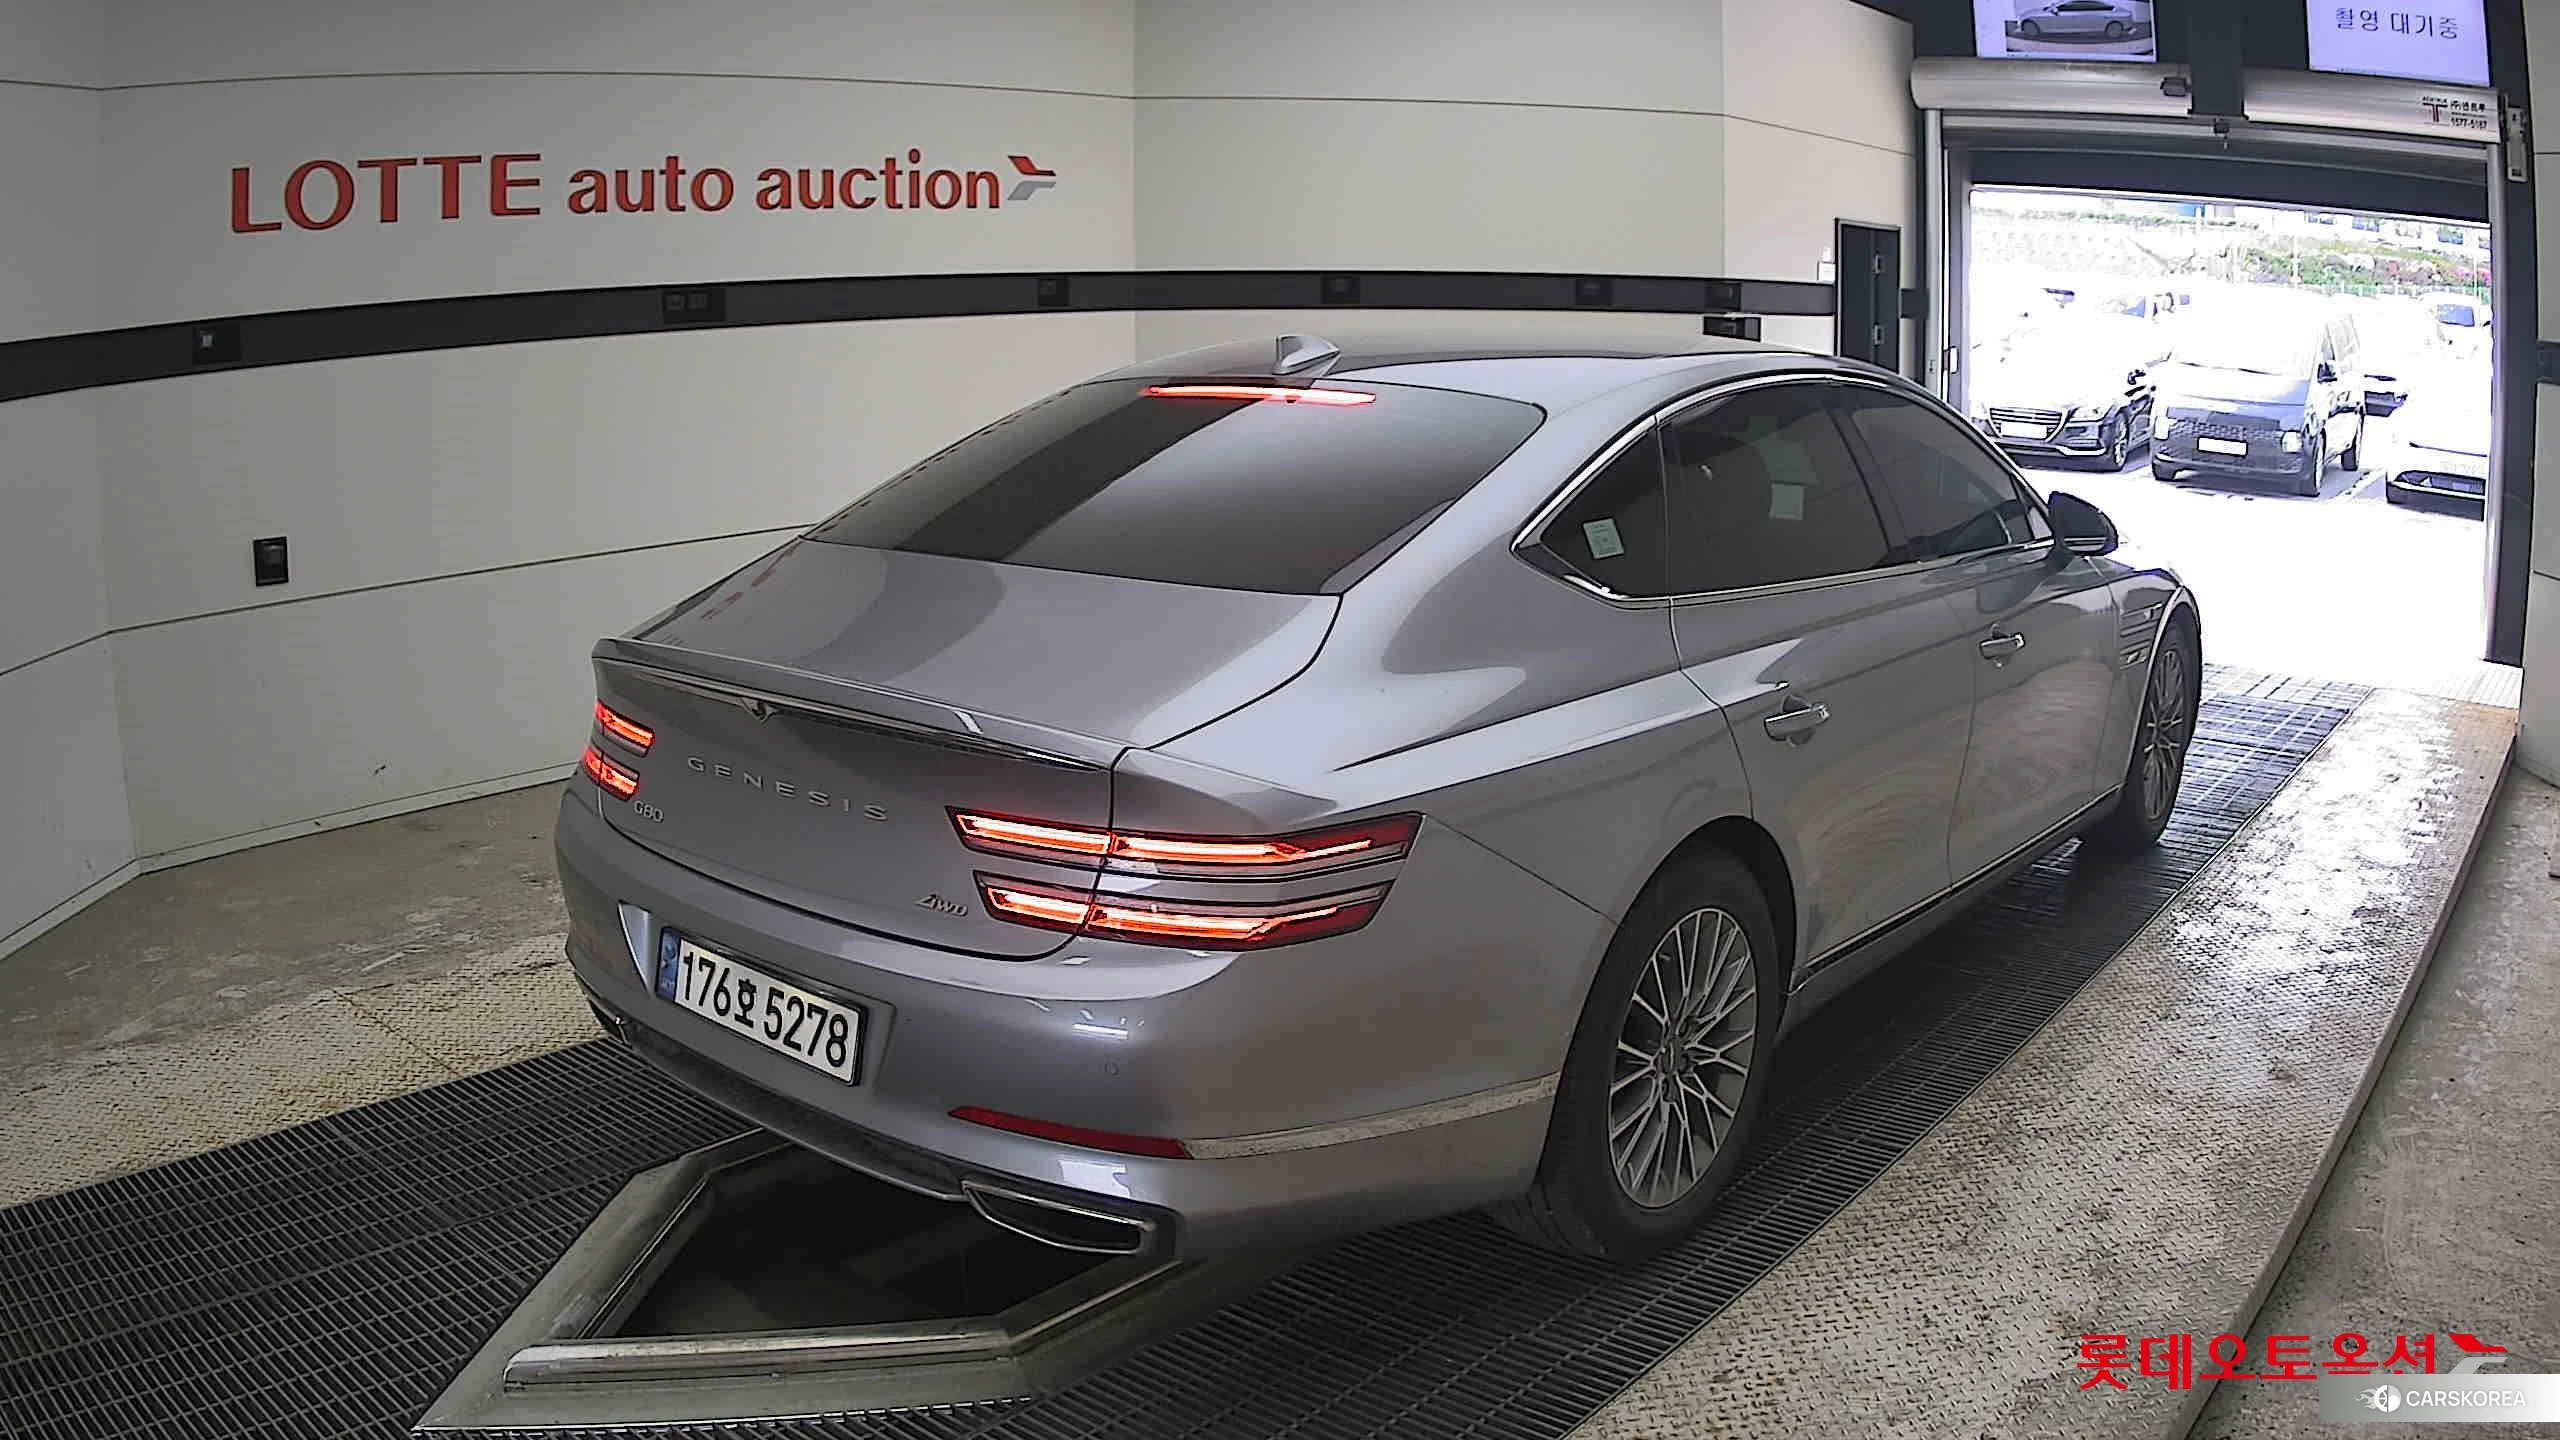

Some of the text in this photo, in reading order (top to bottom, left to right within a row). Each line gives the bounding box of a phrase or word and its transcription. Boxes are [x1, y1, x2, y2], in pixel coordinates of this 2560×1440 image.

[2390, 12, 2459, 40] 대기중
[230, 148, 1002, 235] LOTTE auto auction
[632, 799, 665, 824] G80
[687, 756, 888, 821] GENESIS
[682, 950, 850, 1069] 176호 5278
